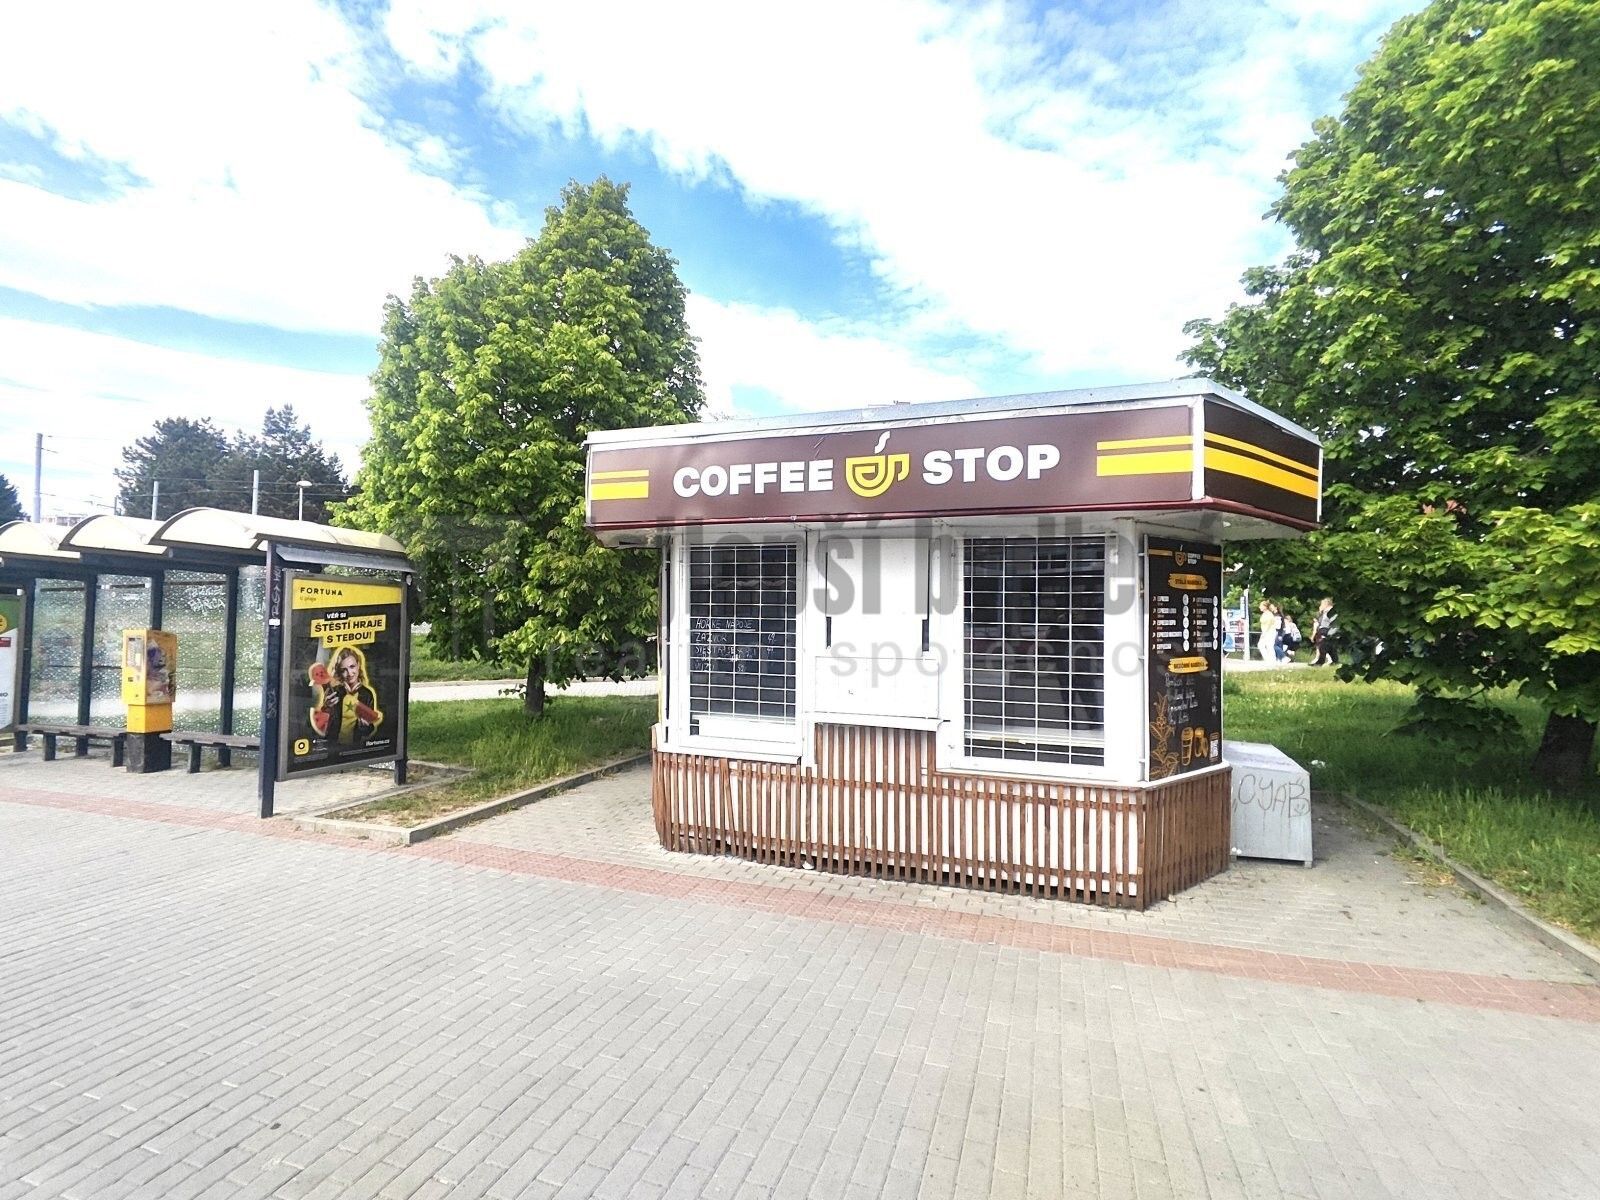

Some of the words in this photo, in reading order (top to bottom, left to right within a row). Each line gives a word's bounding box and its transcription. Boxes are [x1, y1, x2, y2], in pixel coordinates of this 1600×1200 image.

[672, 459, 834, 498] COFFEE
[922, 444, 1061, 485] STOP
[300, 587, 343, 596] FORTUNA
[315, 620, 350, 633] ŠTĚSTÍ
[353, 619, 383, 630] HRAJE
[326, 635, 334, 644] S
[336, 632, 372, 643] TEBOU!
